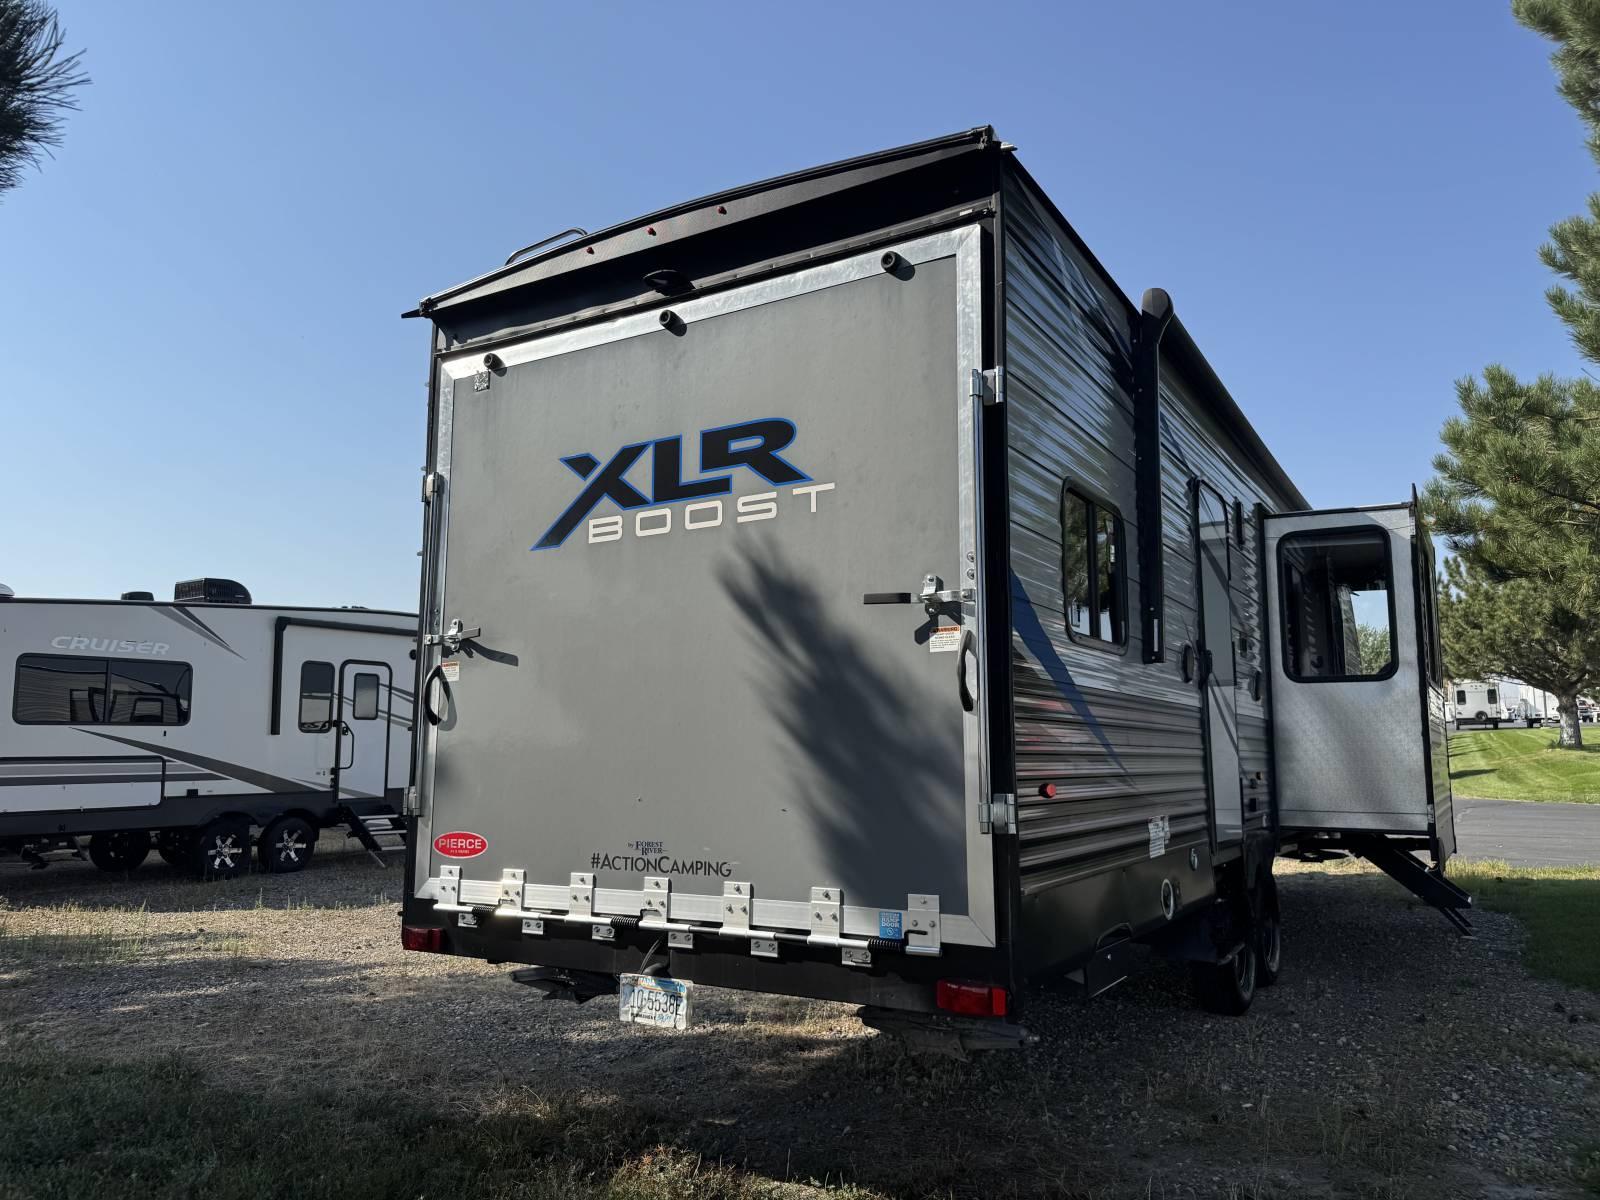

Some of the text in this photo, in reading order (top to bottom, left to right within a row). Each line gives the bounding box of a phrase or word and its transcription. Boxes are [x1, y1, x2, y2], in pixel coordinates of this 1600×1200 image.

[530, 417, 814, 551] XLR
[588, 482, 835, 544] BOOST
[51, 636, 170, 655] CRUISER
[438, 838, 482, 849] PIERCE
[641, 848, 664, 856] RIVER
